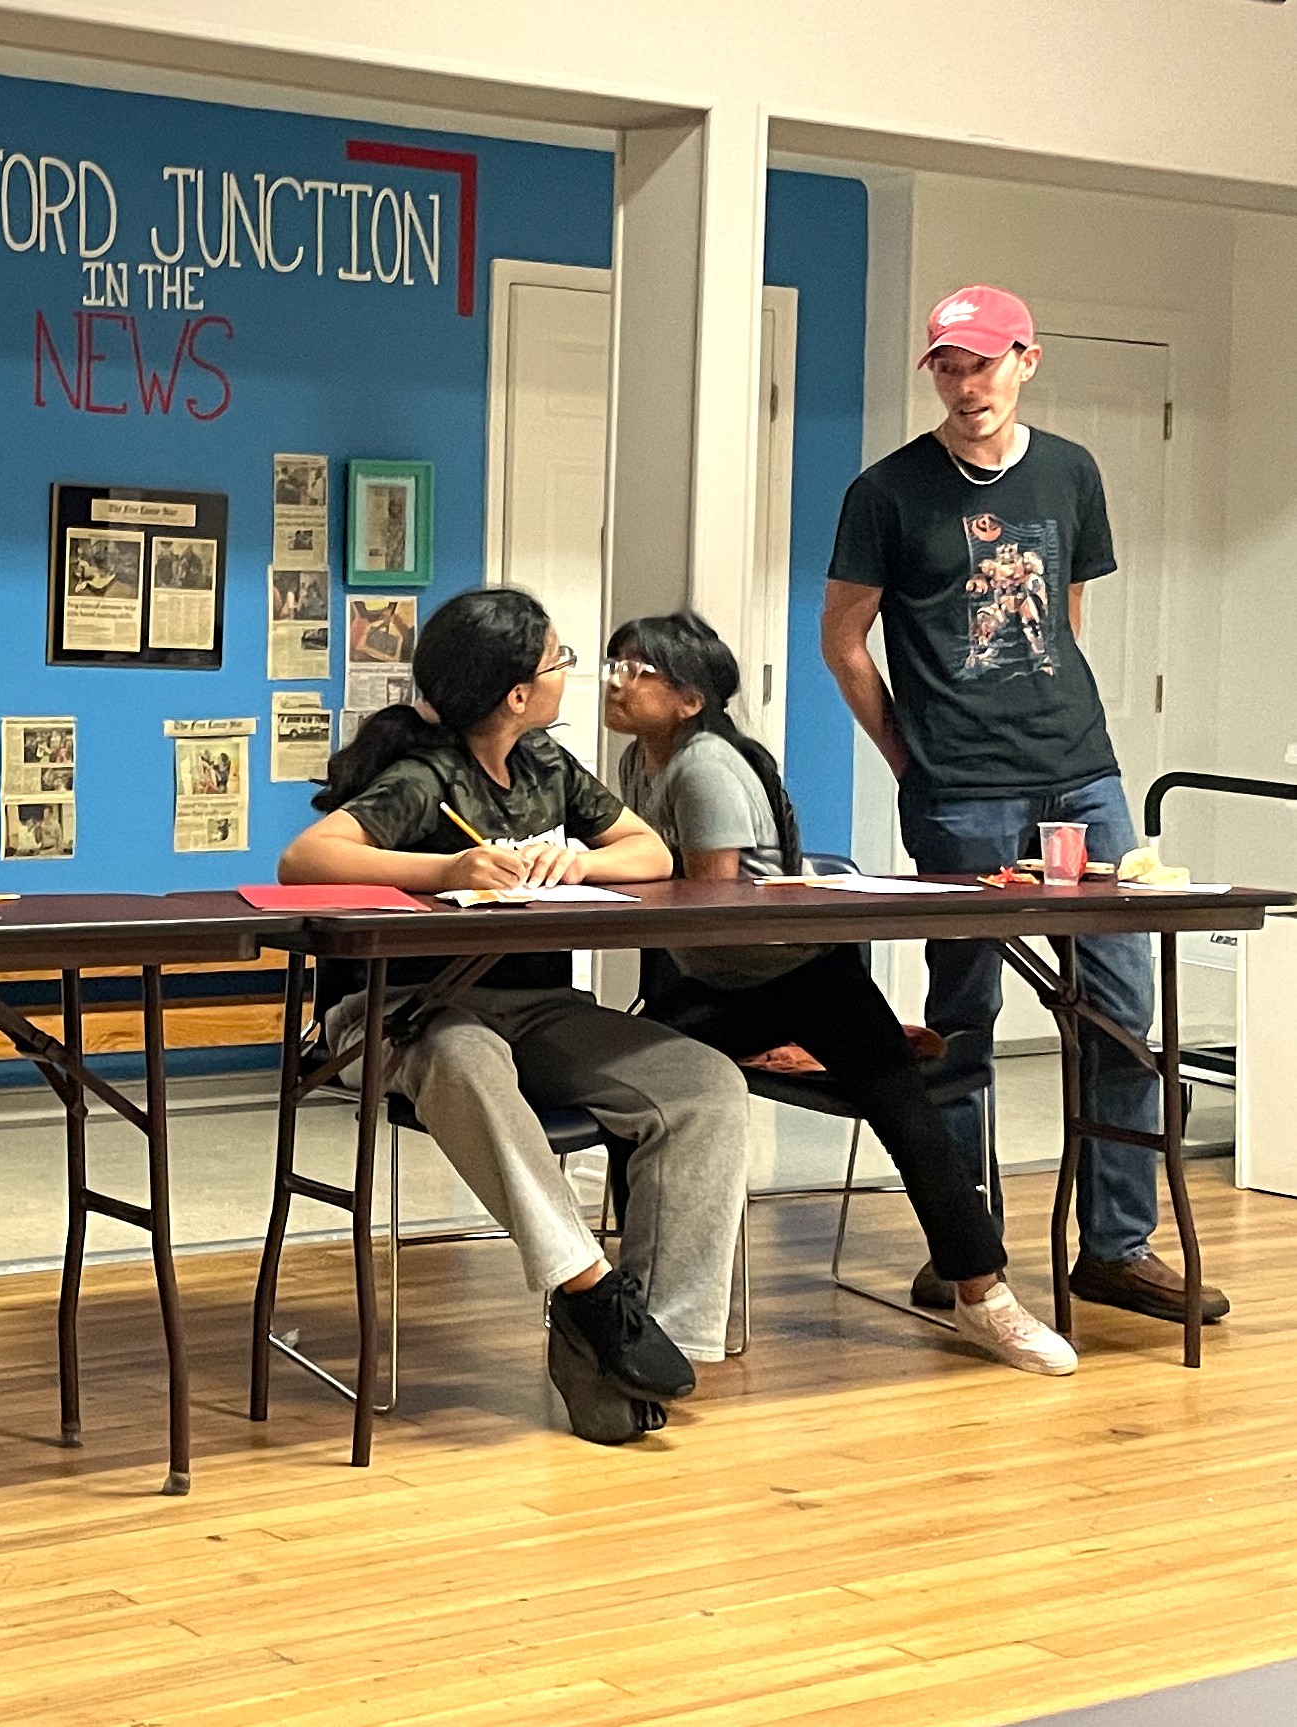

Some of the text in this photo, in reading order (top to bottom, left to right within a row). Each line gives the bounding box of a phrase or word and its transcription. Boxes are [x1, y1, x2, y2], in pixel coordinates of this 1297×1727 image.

[151, 166, 440, 285] JUNCTION
[82, 261, 204, 310] IN THE
[35, 310, 234, 421] NEWS
